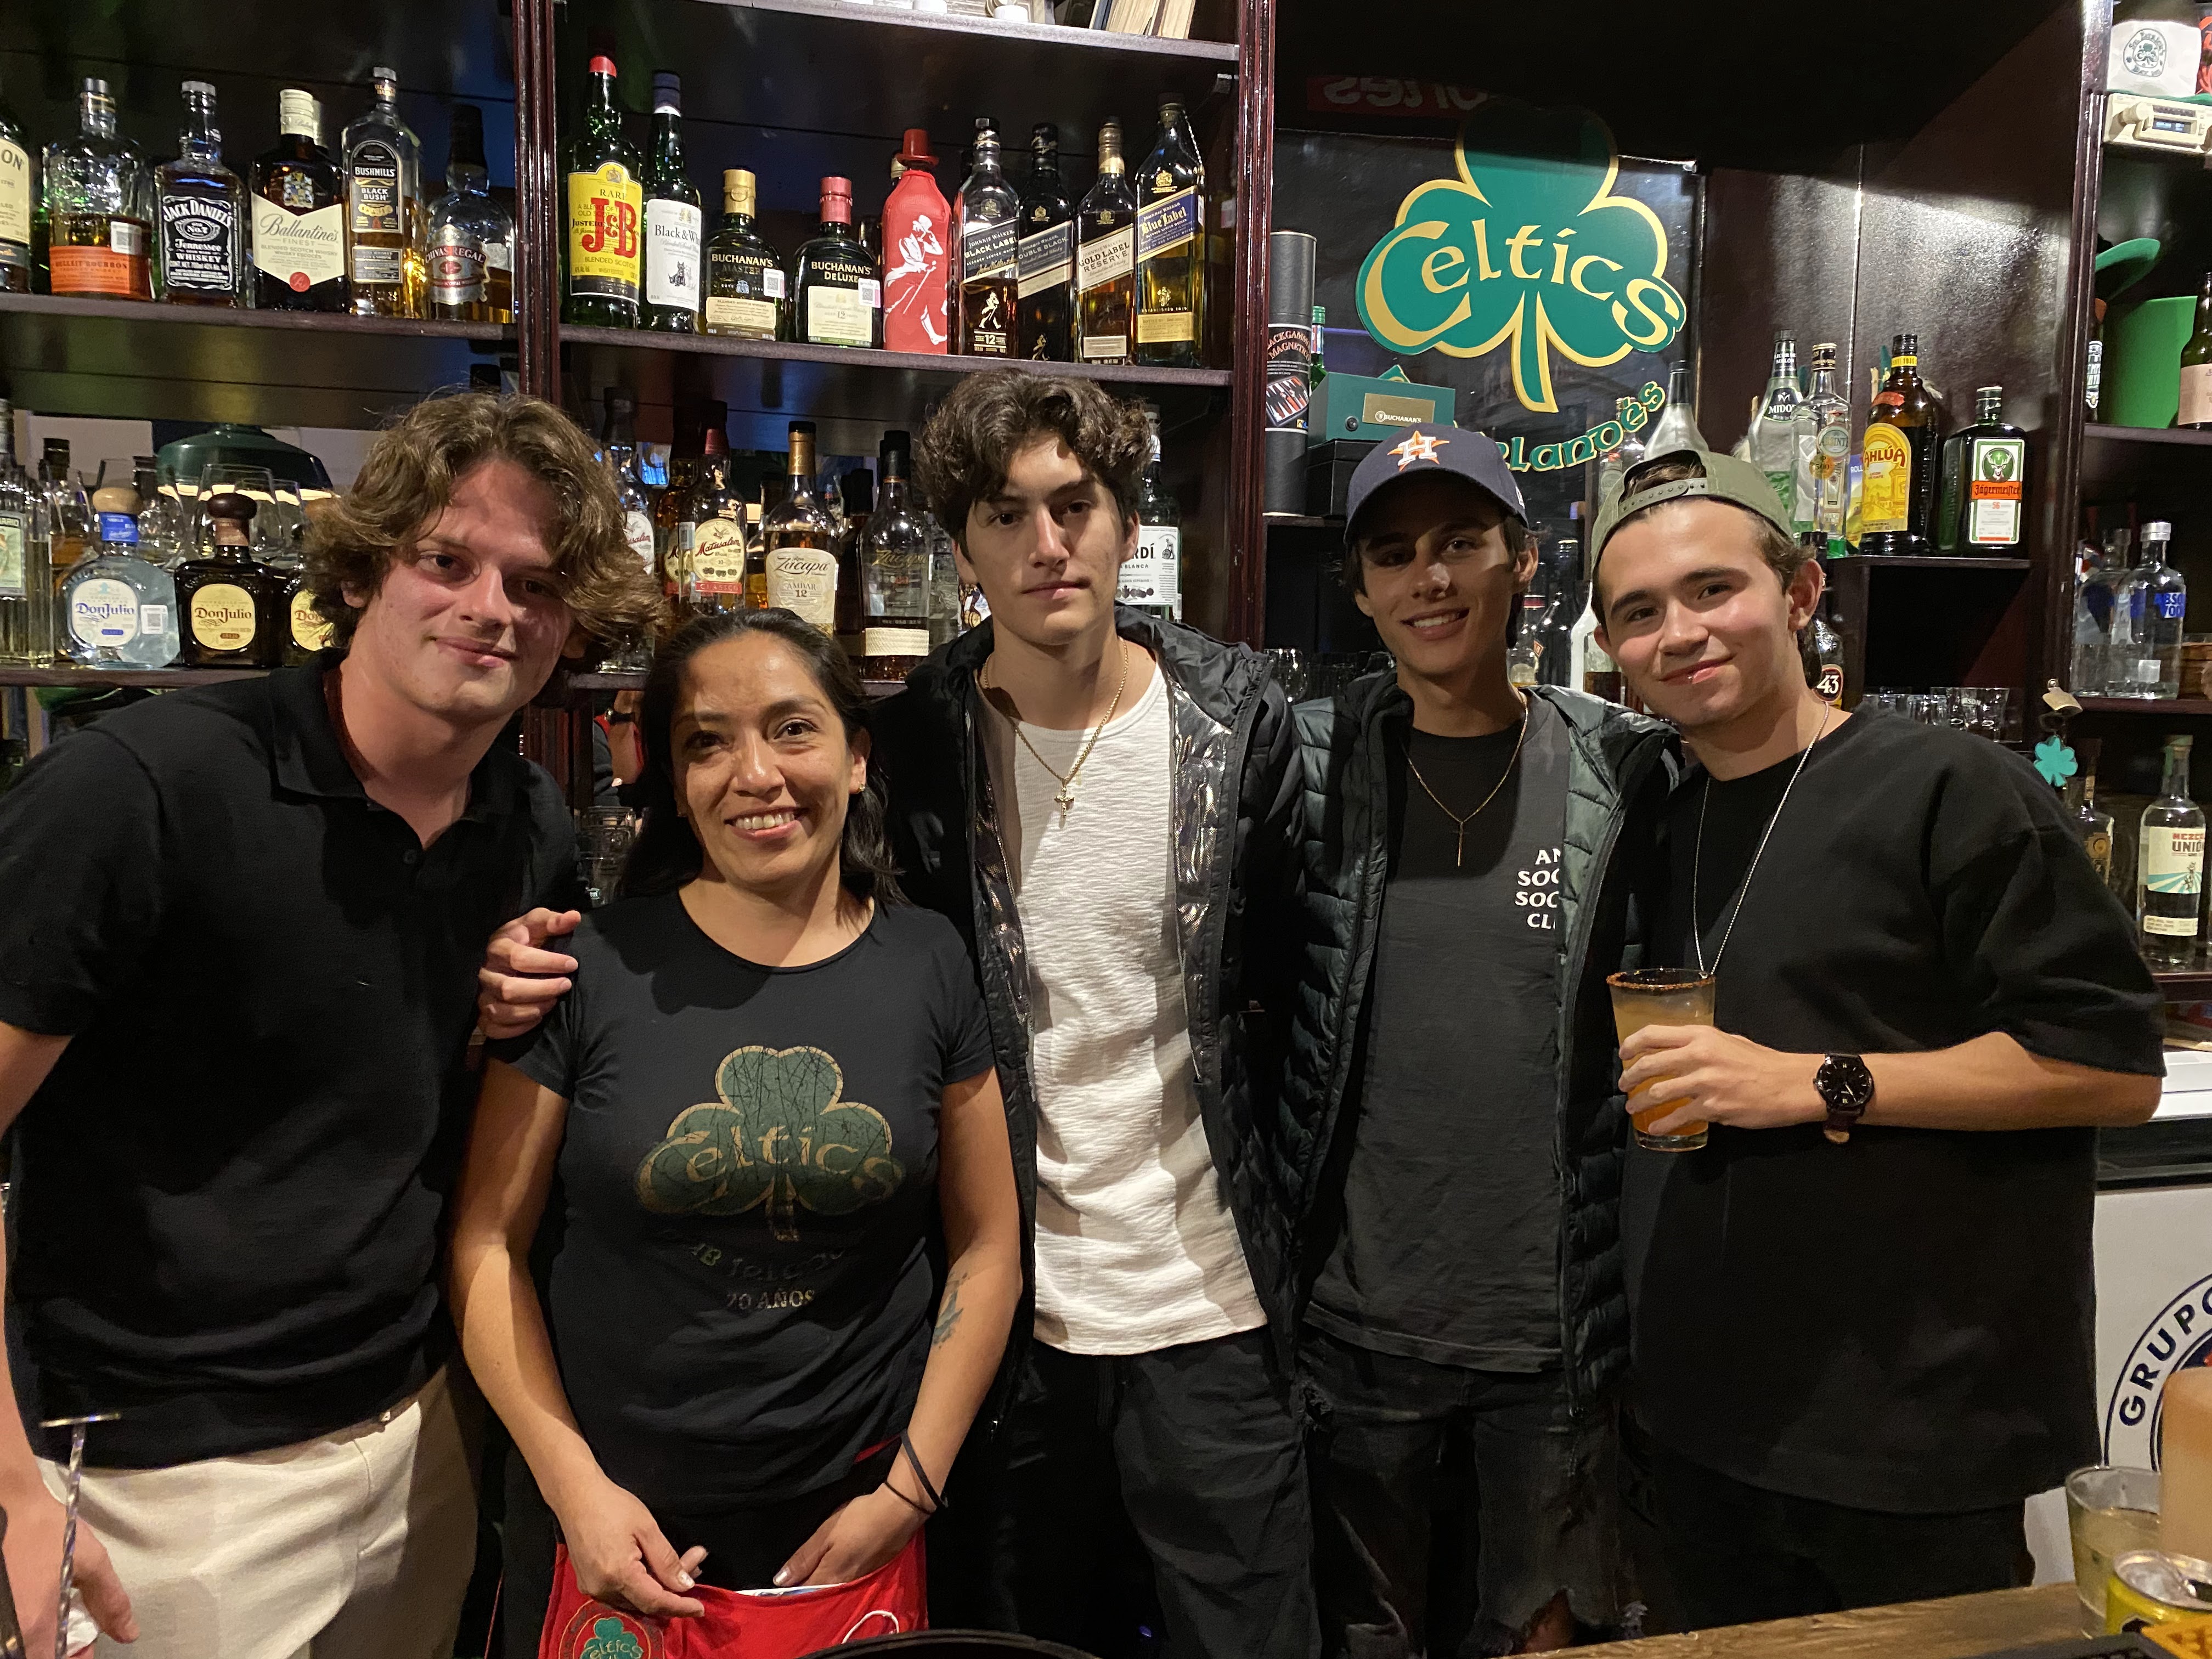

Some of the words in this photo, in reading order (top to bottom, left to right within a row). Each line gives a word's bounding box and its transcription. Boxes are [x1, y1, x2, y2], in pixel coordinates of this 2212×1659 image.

[355, 166, 396, 177] BUSHMILLS
[600, 189, 628, 200] RARE
[163, 204, 190, 222] JACK
[190, 200, 233, 227] DANIEL'S
[1139, 219, 1163, 236] Blue
[1161, 206, 1187, 227] Label
[259, 213, 339, 242] Ballantine's
[654, 224, 681, 239] Black
[681, 230, 689, 241] &
[283, 238, 315, 246] FINEST
[964, 244, 992, 258] BLACK
[993, 237, 1018, 249] LABEL
[969, 236, 991, 249] JOHNNIE
[991, 230, 1014, 240] WALKER
[1018, 247, 1042, 259] OUBLE
[1043, 237, 1068, 249] BLACK
[176, 253, 221, 263] WHISKEY
[425, 247, 449, 264] CHIVAS
[453, 248, 484, 262] REGAL
[1103, 241, 1130, 258] LABEL
[615, 259, 636, 270] SCOTCH
[712, 254, 774, 268] BUCHANAN'S
[811, 261, 871, 275] BUCHANAN'S
[1084, 250, 1128, 273] RESERVE
[1364, 218, 1681, 348] Celtics
[985, 334, 996, 345] 12
[1768, 404, 1796, 415] MIDO
[1384, 414, 1422, 423] BUCHANAN'S
[1481, 381, 1666, 472] landés
[1397, 436, 1437, 466] H
[1863, 445, 1906, 467] AHLÚA
[1975, 484, 2021, 496] Jägermeister
[1992, 501, 2001, 510] 56
[695, 537, 741, 557] Matusalem
[772, 555, 830, 575] Zacapa
[76, 602, 105, 614] Don
[101, 603, 135, 619] Julio
[195, 607, 224, 618] Don
[219, 607, 252, 623] Julio
[1816, 675, 1839, 694] 43
[1527, 913, 1556, 930] CL
[638, 1126, 903, 1214] Celtics
[756, 1288, 815, 1310] AÑOS
